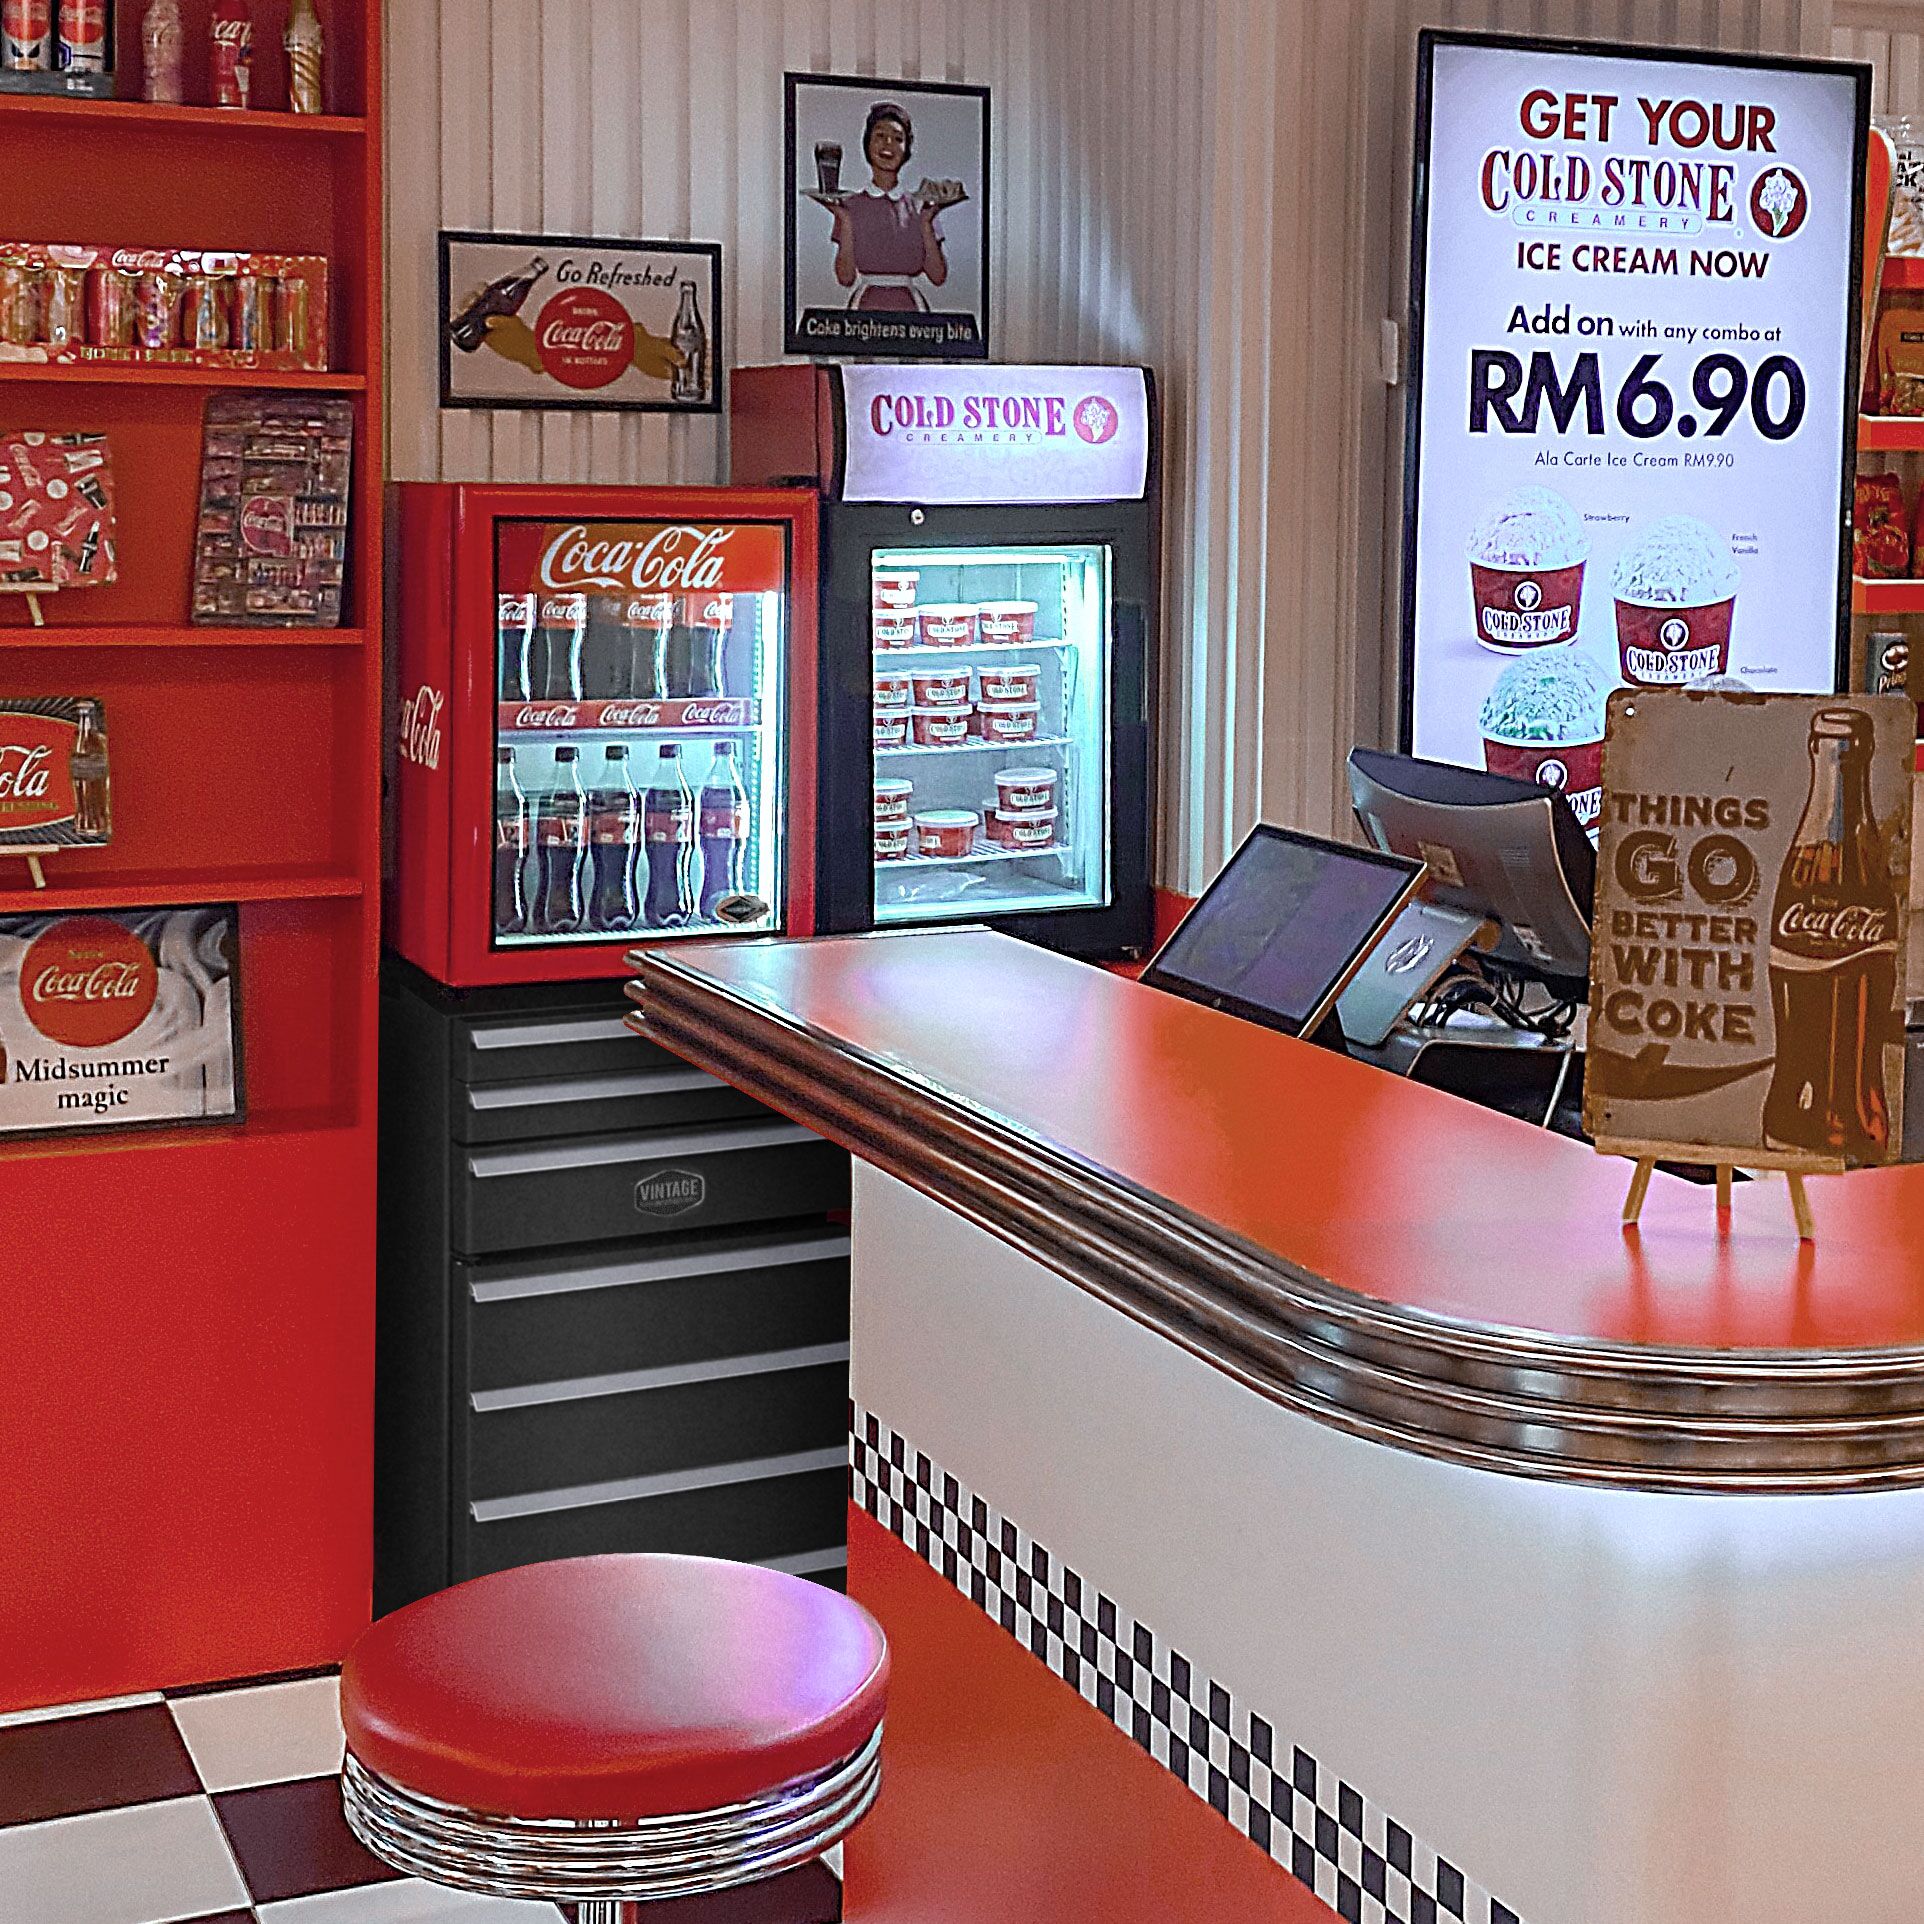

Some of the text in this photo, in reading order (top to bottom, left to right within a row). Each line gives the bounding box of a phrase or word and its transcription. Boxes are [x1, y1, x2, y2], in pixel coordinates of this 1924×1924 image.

[1519, 89, 1777, 153] GET YOUR
[1481, 149, 1735, 222] COLD STONE
[1525, 209, 1690, 230] CREAMERY
[556, 259, 678, 289] Go Refreshed
[1517, 242, 1770, 279] ICE CREAM NOW
[806, 317, 973, 344] Coke brightens every bite
[1506, 302, 1782, 344] Add on with any combo at
[870, 394, 1067, 437] COLD STONE
[905, 433, 1033, 443] CREAMERY
[1534, 451, 1559, 467] Ala
[1563, 451, 1601, 468] Carte
[1607, 452, 1628, 468] Ice
[1632, 453, 1680, 468] Cream
[1484, 608, 1569, 632] COLD STONE
[1628, 649, 1719, 673] COLD STONE
[1611, 792, 1770, 831] THINGS
[1614, 829, 1762, 908] GO
[1611, 910, 1759, 945] BETTER
[1610, 944, 1754, 992] WITH
[1604, 989, 1757, 1046] COKE
[14, 1056, 170, 1083] Midsummer
[57, 1083, 129, 1114] magic
[639, 1179, 699, 1201] VINTAGE
